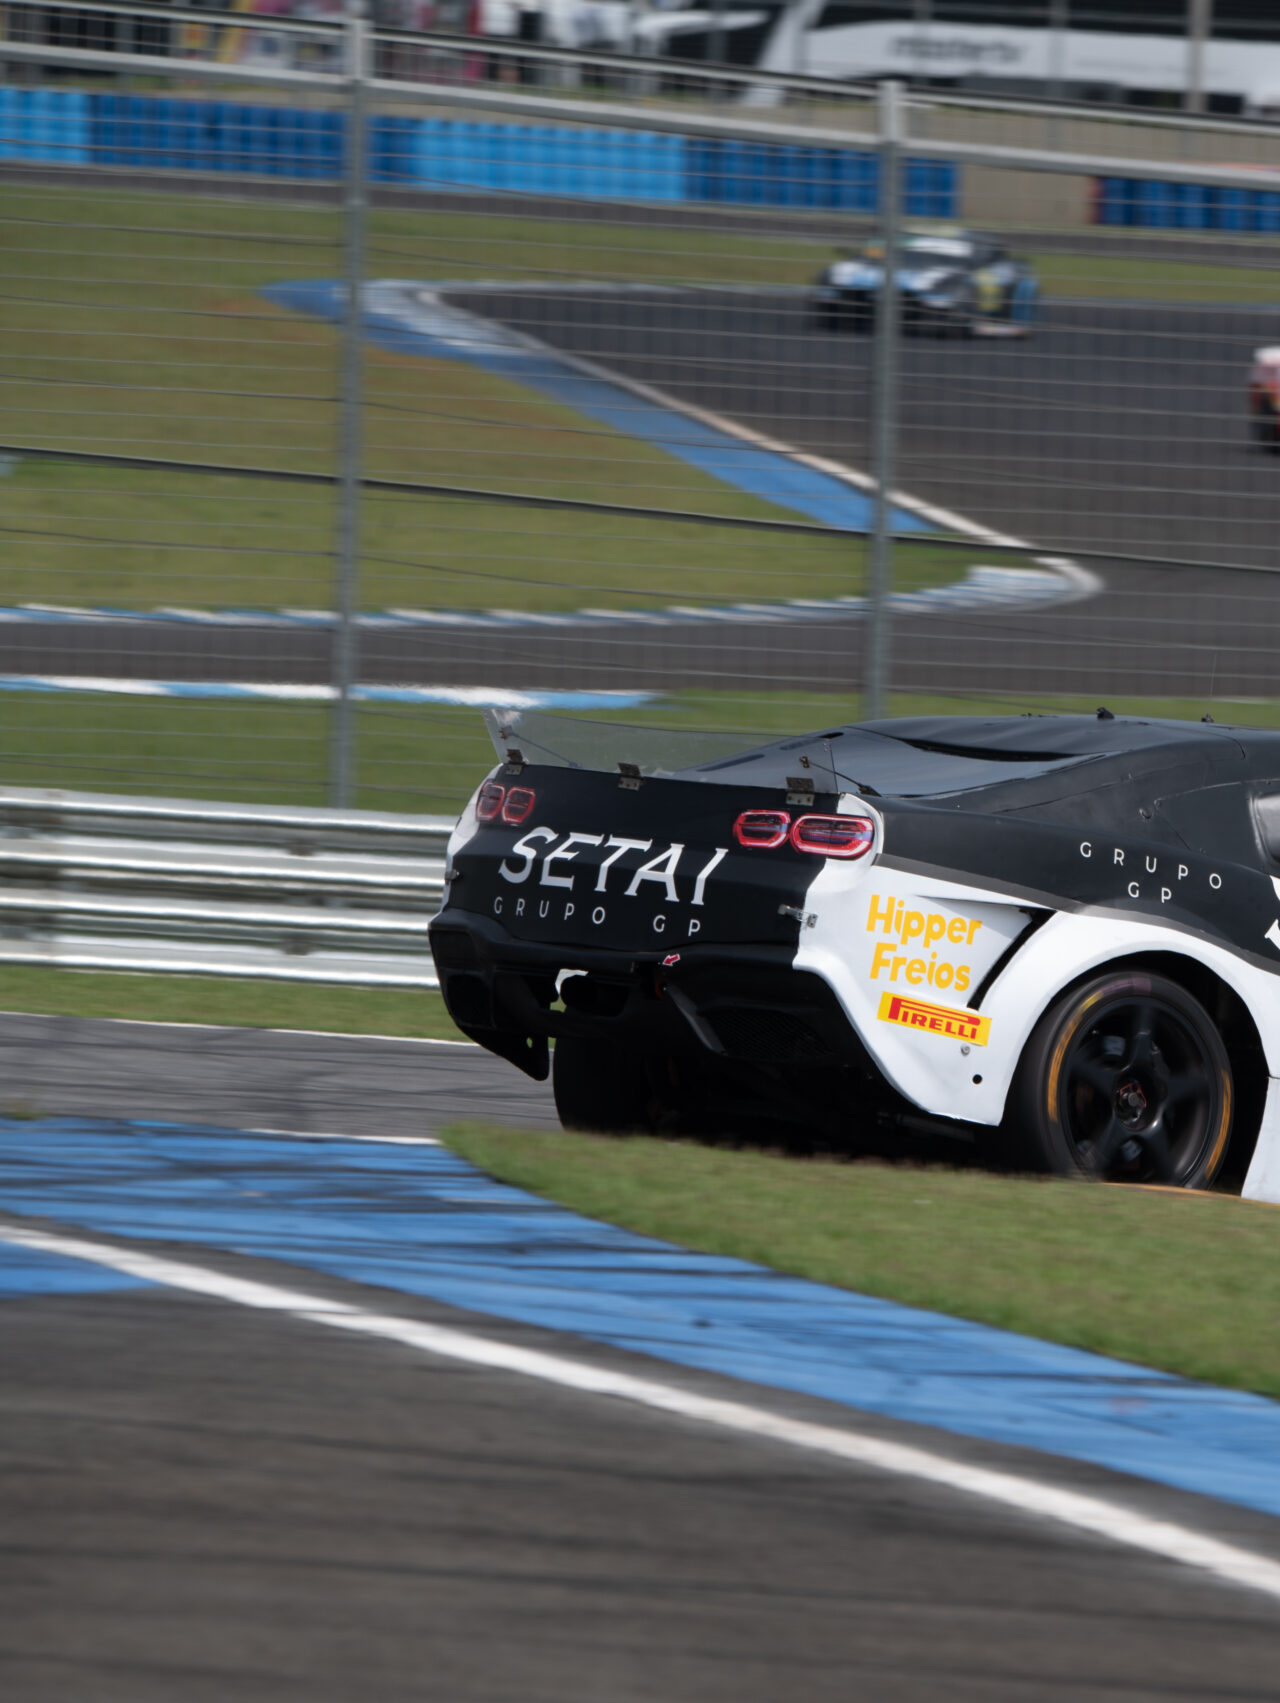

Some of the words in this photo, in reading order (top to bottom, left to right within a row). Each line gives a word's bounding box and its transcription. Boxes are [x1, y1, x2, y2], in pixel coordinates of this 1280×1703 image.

[498, 827, 729, 905] SETAI
[1080, 842, 1222, 889] GRUPO
[1128, 882, 1172, 903] GP
[494, 896, 606, 925] GRUPO
[653, 915, 701, 937] GP
[866, 894, 982, 948] Hipper
[869, 942, 971, 992] Freios
[888, 997, 981, 1039] PIRELLI
